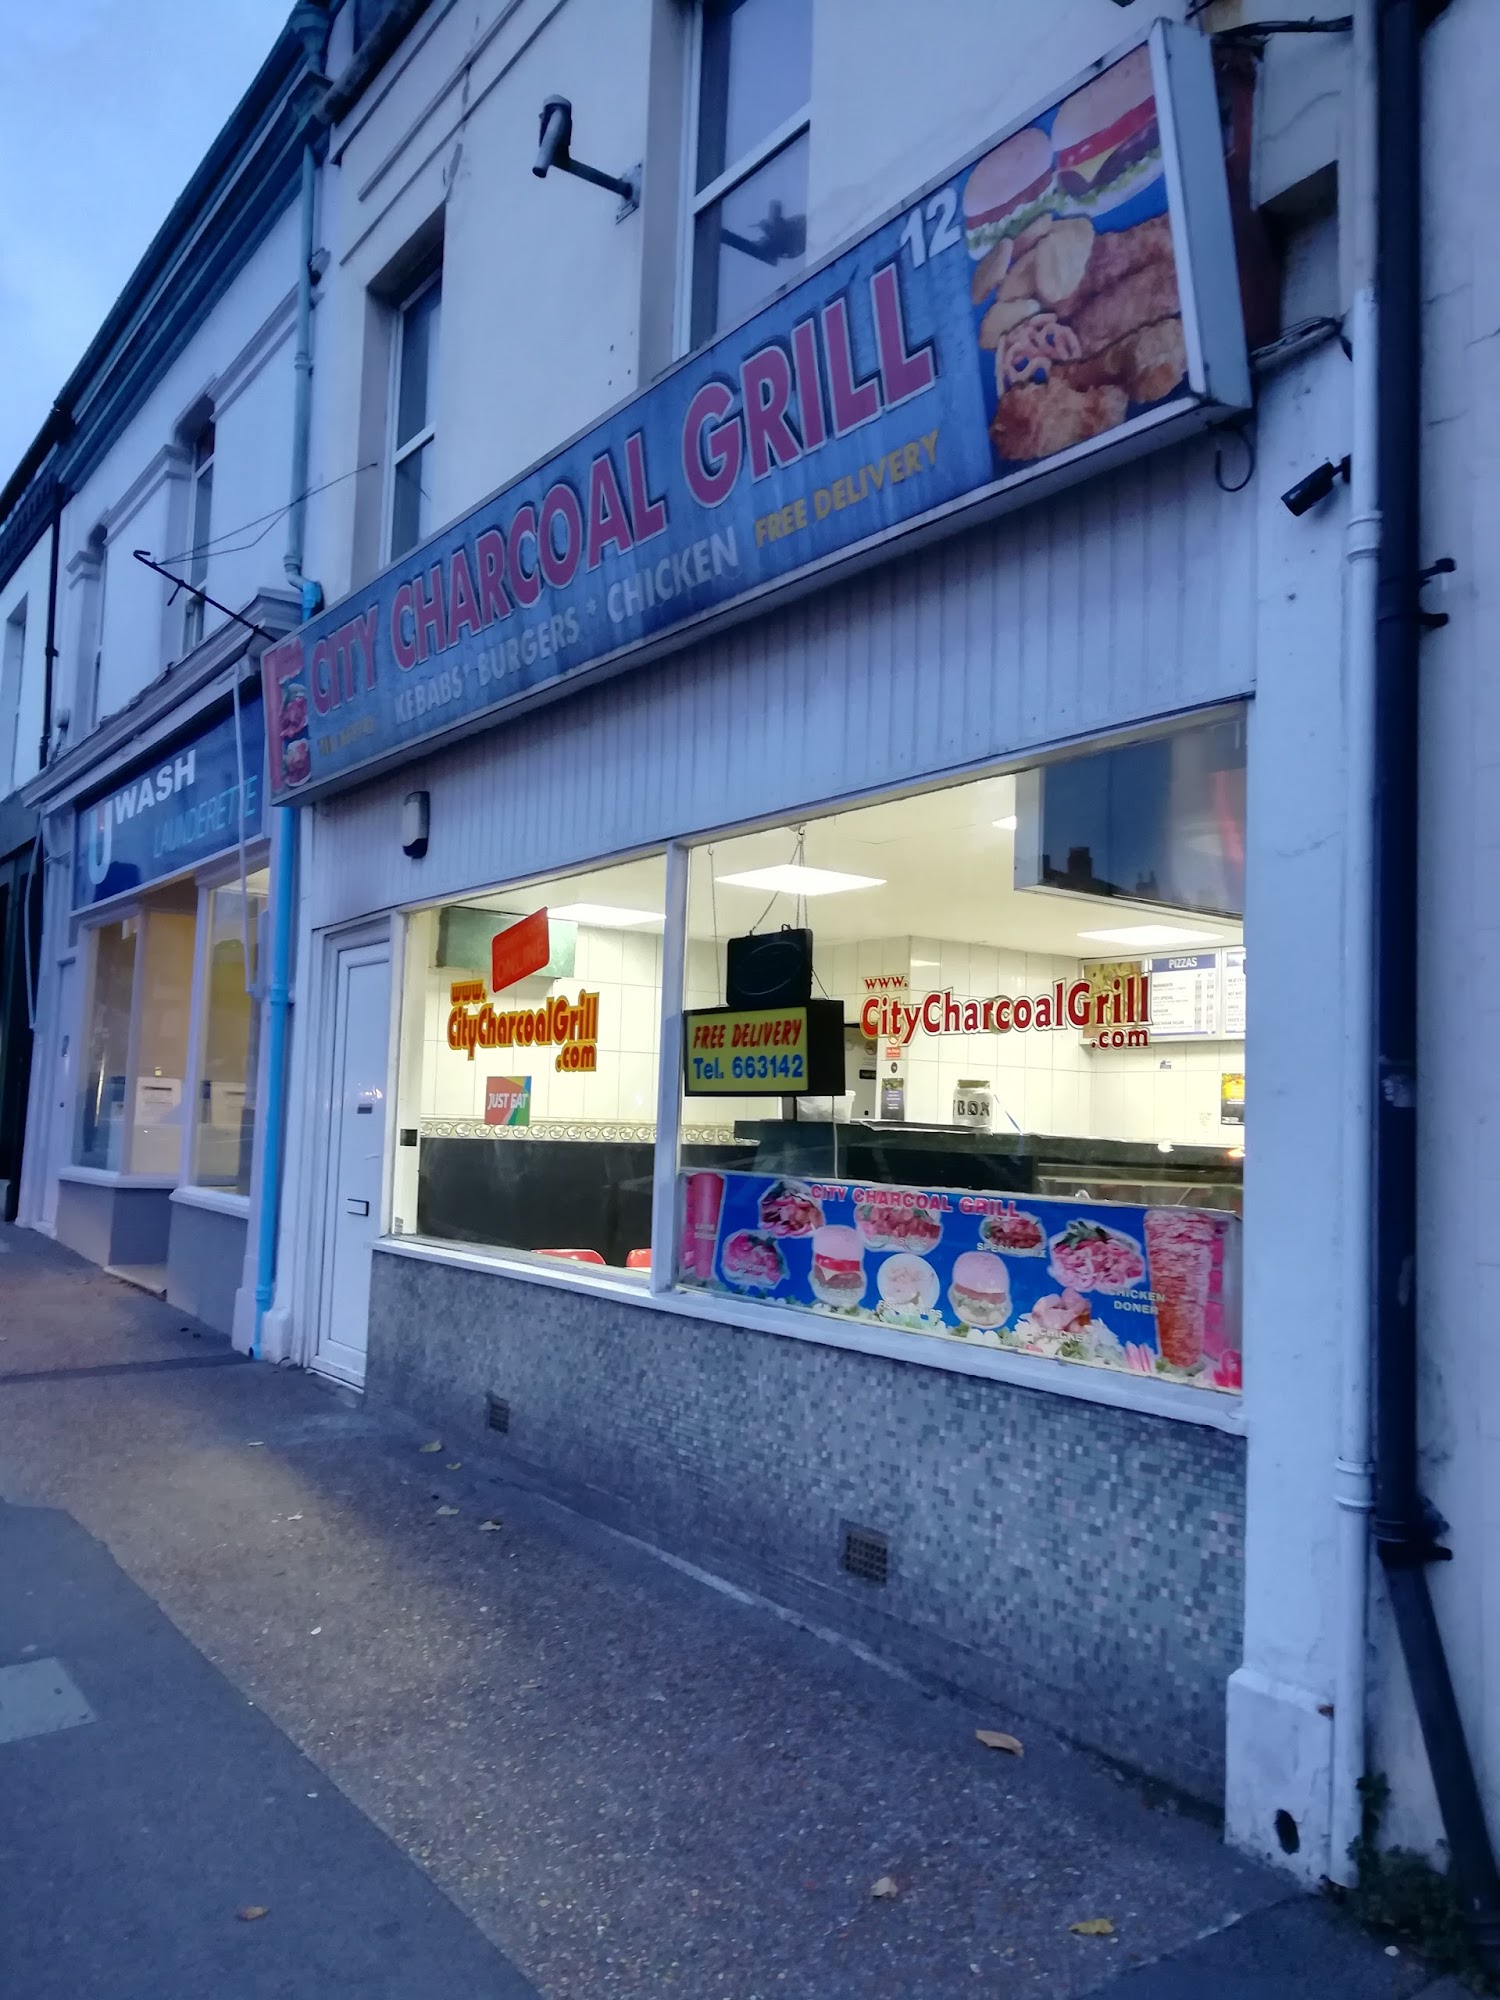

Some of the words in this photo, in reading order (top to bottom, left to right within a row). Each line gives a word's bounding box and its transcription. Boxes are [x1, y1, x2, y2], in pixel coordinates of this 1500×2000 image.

[899, 187, 962, 269] 12
[310, 604, 378, 717] CITY
[390, 432, 668, 673] CHARCOAL
[682, 262, 936, 508] GRILL
[754, 498, 808, 548] FREE
[813, 429, 940, 521] DELIVERY
[394, 670, 464, 724] KEBABS
[477, 606, 580, 687] BURGERS
[606, 526, 739, 623] CHICKEN
[114, 749, 196, 825] WASH
[1168, 957, 1198, 969] PIZZAS
[447, 989, 600, 1060] CityCharcoalGrill
[692, 1023, 725, 1049] FREE
[731, 1018, 802, 1048] DELIVERY
[860, 974, 1150, 1045] CityCharcoalGrill
[692, 1056, 724, 1080] Tel.
[732, 1053, 803, 1080] 663142
[487, 1092, 510, 1110] JUST
[510, 1092, 529, 1109] EAT
[810, 1184, 848, 1202] CITY
[853, 1187, 953, 1212] CHARCOAL
[959, 1197, 1020, 1217] GRILL
[1109, 1287, 1166, 1303] CHICKEN
[1113, 1300, 1160, 1315] DONER
